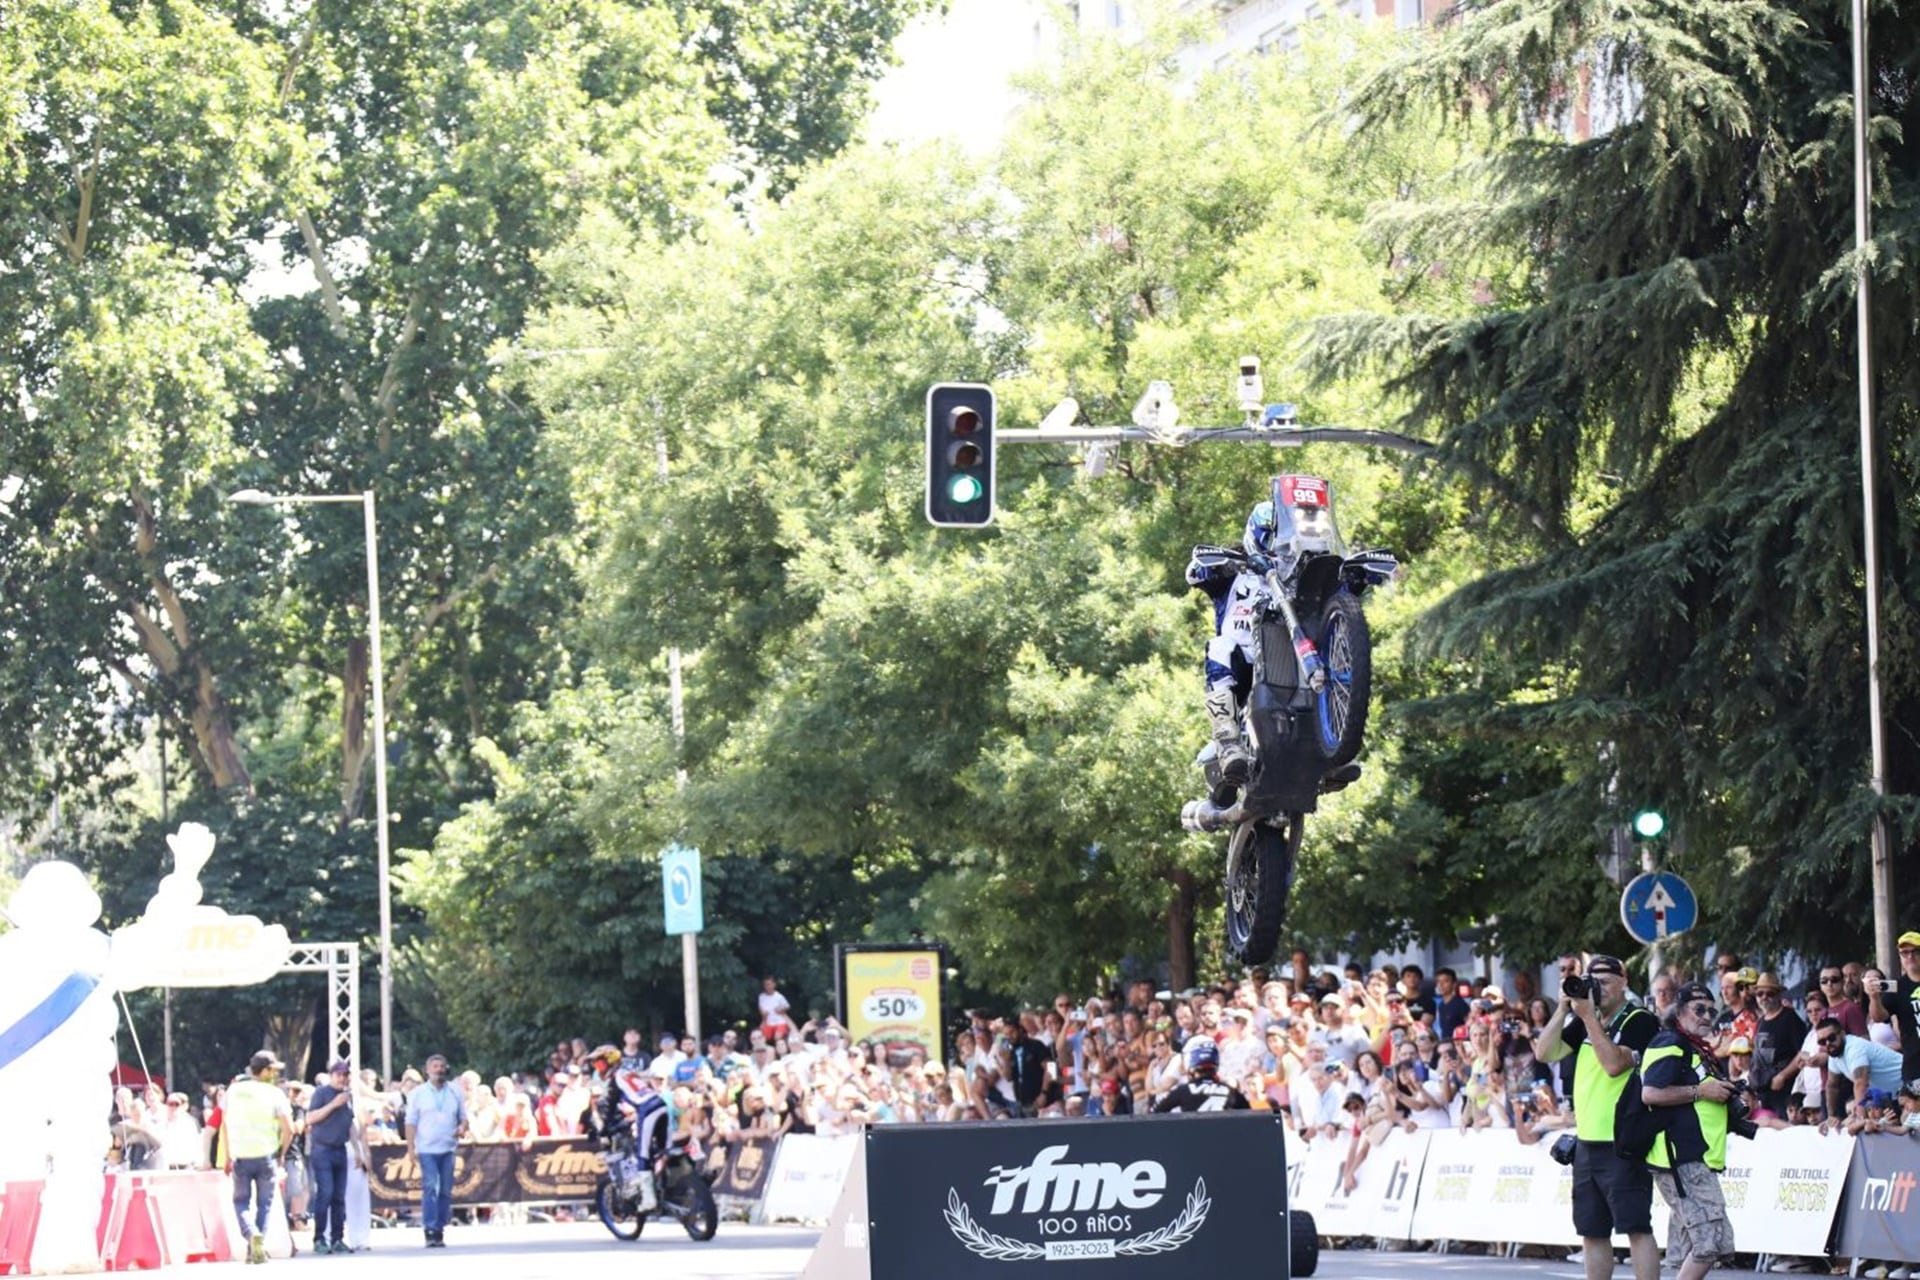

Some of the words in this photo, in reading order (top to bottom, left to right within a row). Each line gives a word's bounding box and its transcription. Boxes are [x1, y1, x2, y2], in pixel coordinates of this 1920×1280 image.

[186, 924, 257, 952] me
[870, 998, 918, 1016] -50%
[983, 1144, 1167, 1215] rfme
[1780, 1167, 1830, 1179] BOUTIQUE
[1774, 1181, 1828, 1211] MOTOR
[1860, 1171, 1917, 1213] mitt
[1038, 1217, 1078, 1235] 100
[1086, 1213, 1132, 1233] AÑOS
[1051, 1241, 1109, 1256] 1923-2023
